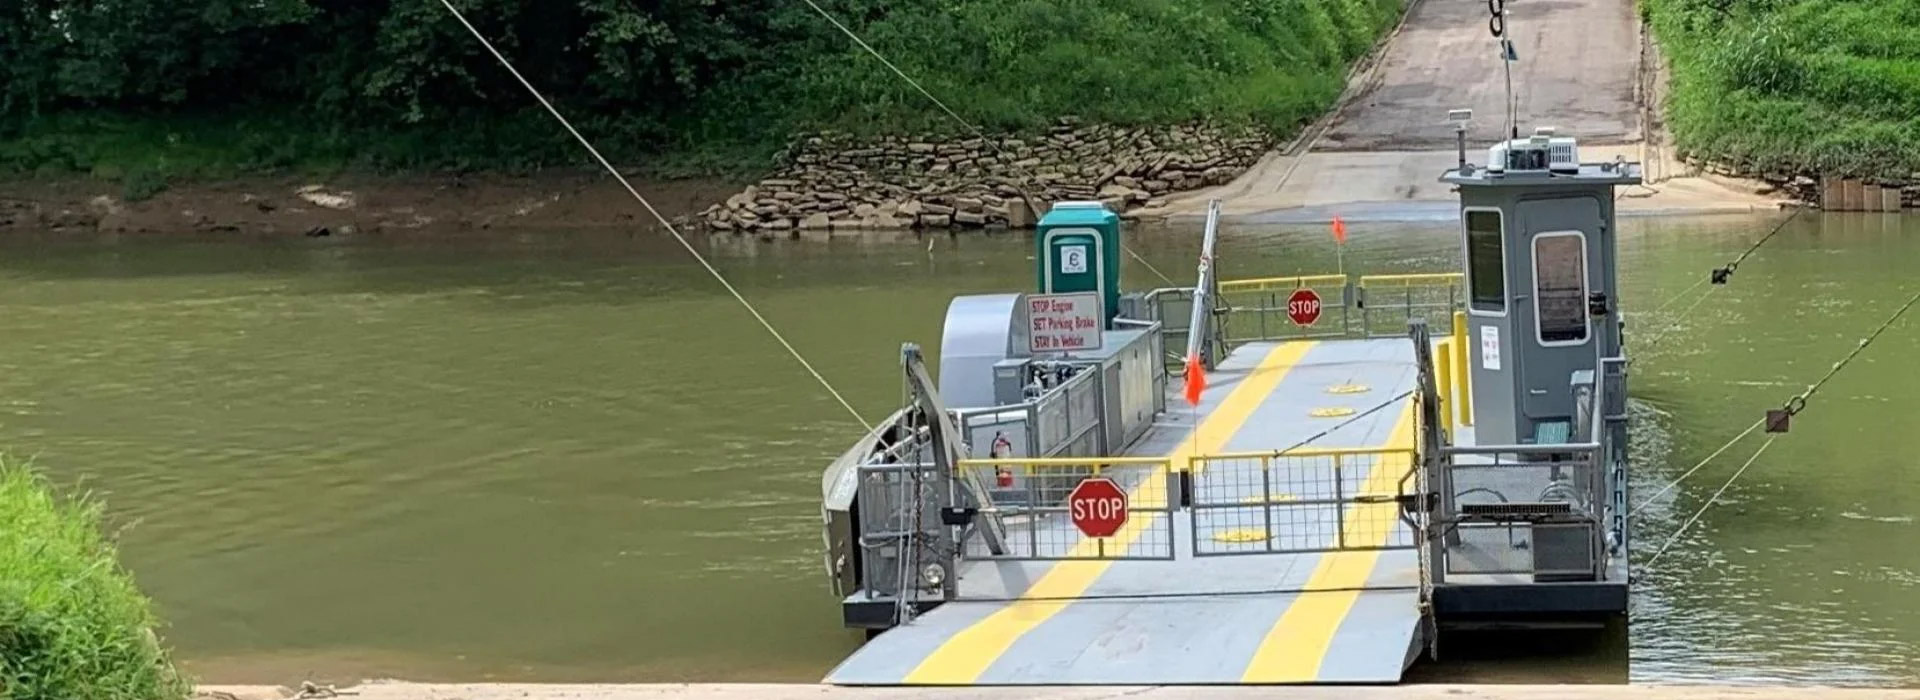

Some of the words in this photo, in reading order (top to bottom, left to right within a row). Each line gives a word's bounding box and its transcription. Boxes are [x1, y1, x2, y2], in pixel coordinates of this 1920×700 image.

[1032, 301, 1049, 312] STOP
[1052, 299, 1073, 314] Engine
[1289, 300, 1319, 315] STOP
[1033, 317, 1046, 330] SET
[1048, 318, 1073, 331] Parking
[1075, 316, 1094, 328] Brake
[1034, 336, 1049, 347] STAY
[1061, 336, 1083, 347] Vehicle
[1074, 498, 1123, 520] STOP
